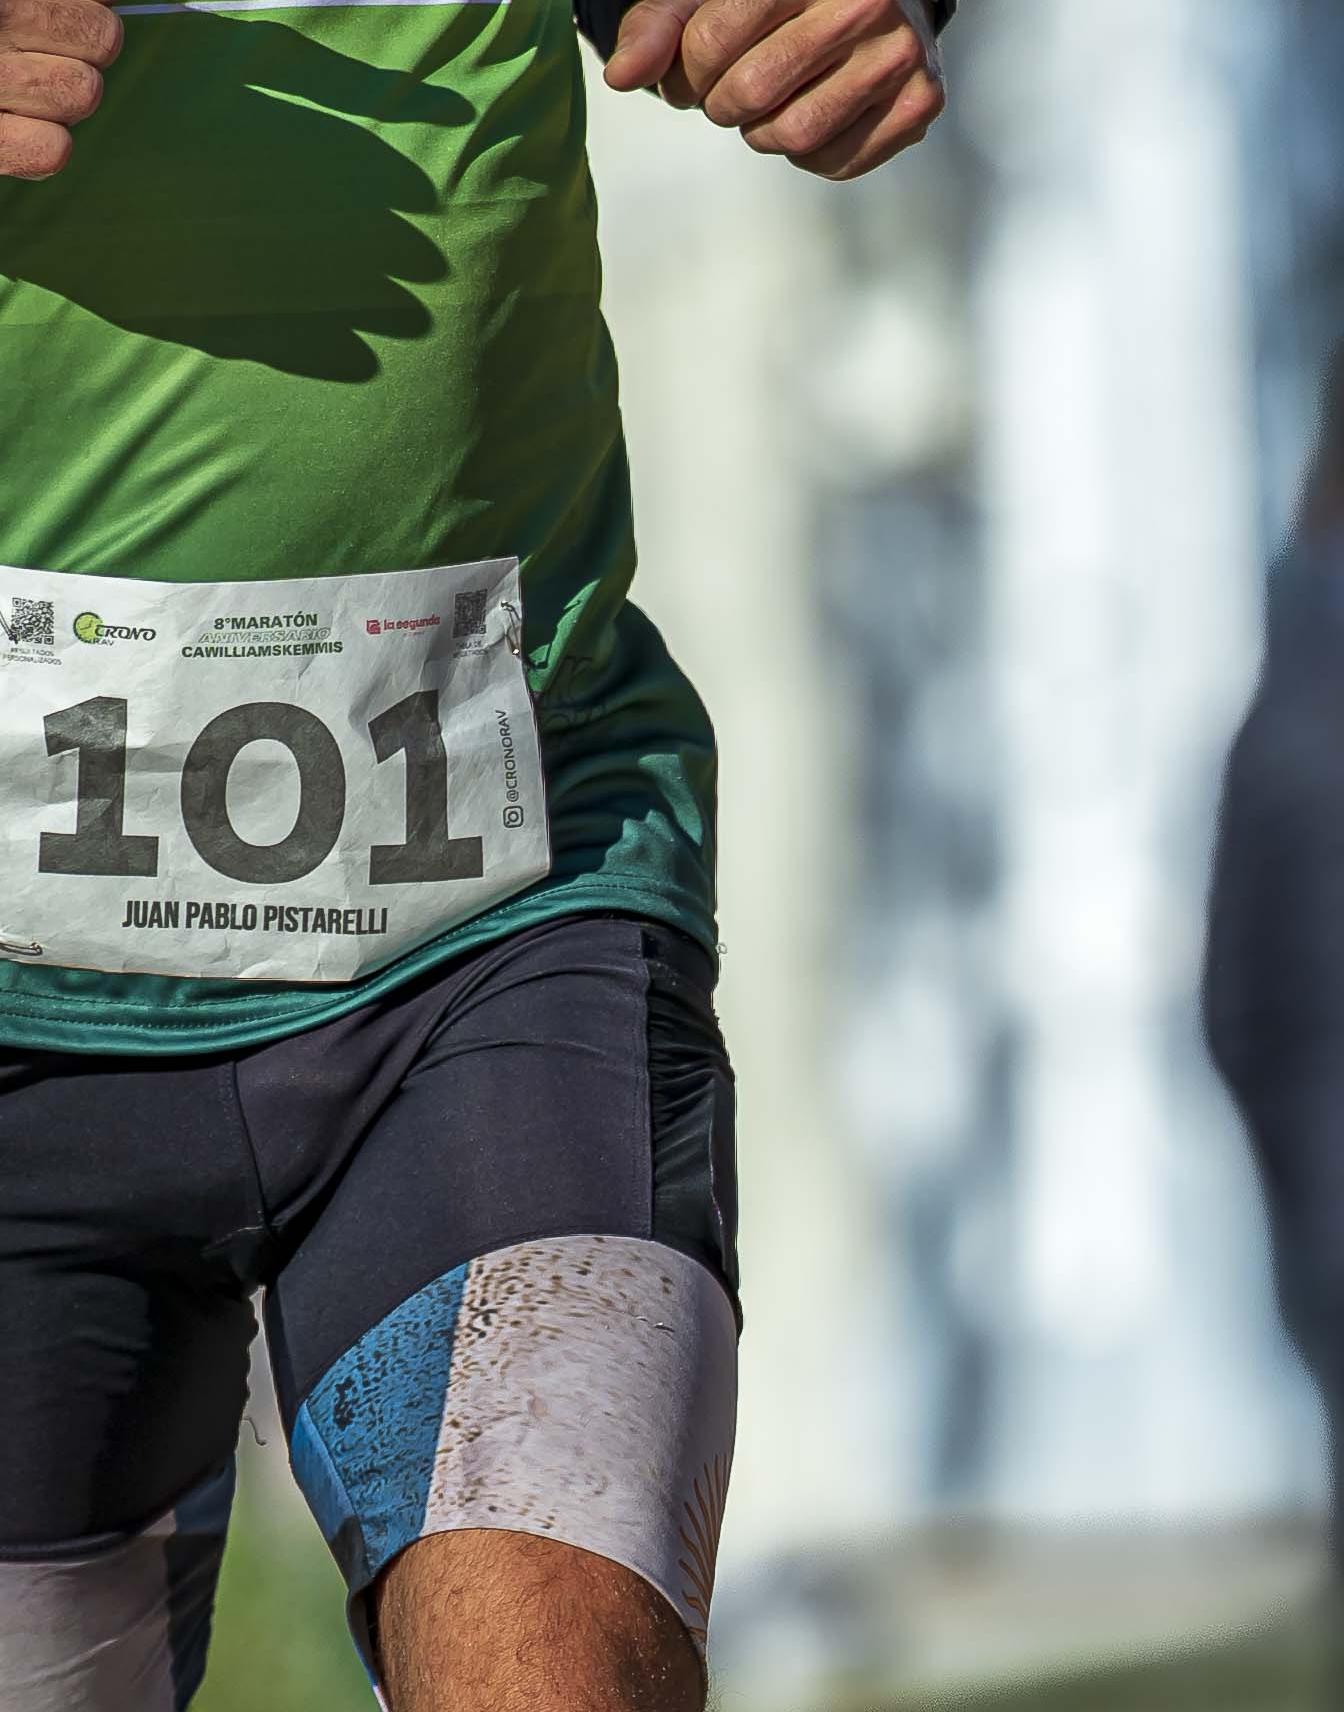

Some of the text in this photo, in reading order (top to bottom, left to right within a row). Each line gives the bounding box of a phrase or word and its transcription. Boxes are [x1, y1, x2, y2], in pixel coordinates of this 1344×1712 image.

[94, 624, 157, 641] CRONO
[198, 628, 332, 644] ANIVERSARIO
[181, 641, 344, 658] CAWILLIAMSKEMMIS
[495, 709, 520, 803] @CRONORAV
[38, 689, 484, 884] 101
[122, 900, 389, 935] JUAN PABLO PISTARELLI
